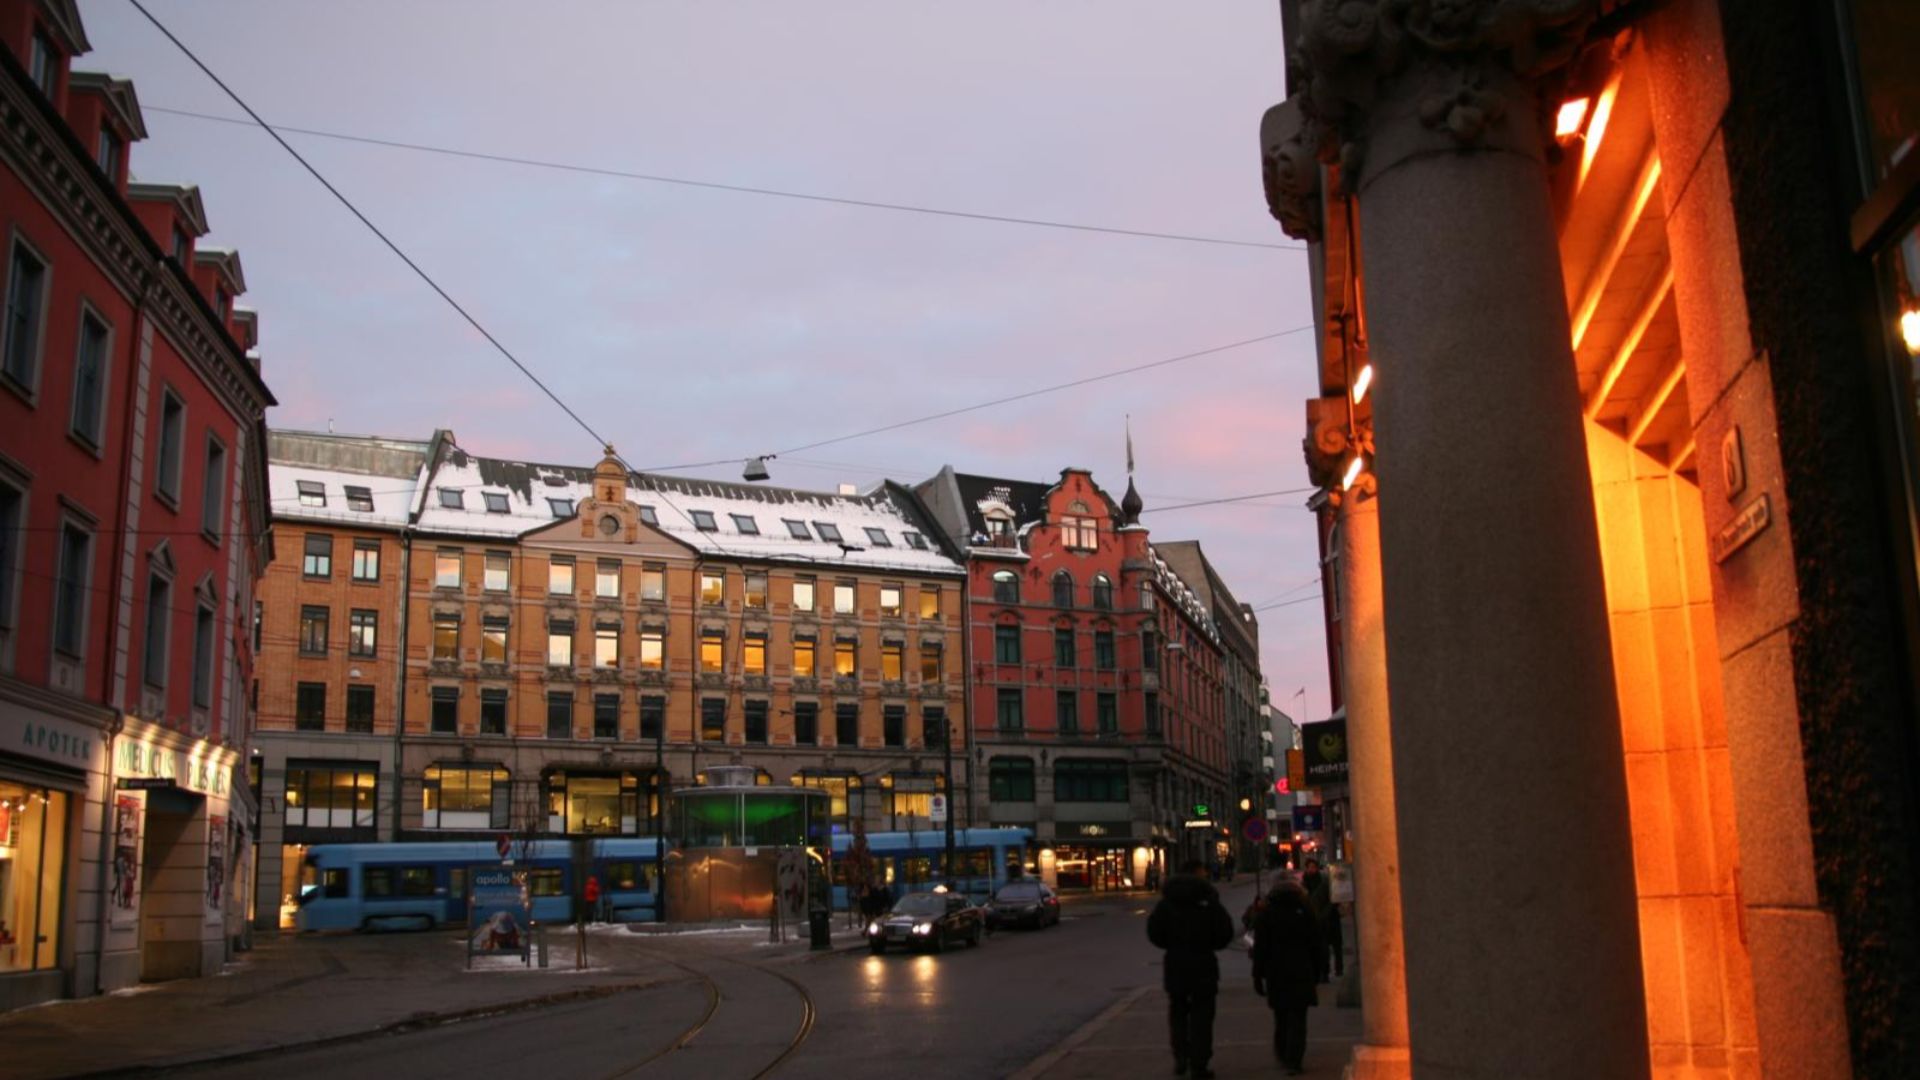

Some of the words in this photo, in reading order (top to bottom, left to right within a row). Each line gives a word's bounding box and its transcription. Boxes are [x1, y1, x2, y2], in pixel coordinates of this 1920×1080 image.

[23, 721, 90, 760] APOTEK
[118, 740, 175, 778] MEDICUS
[475, 871, 510, 886] apollo
